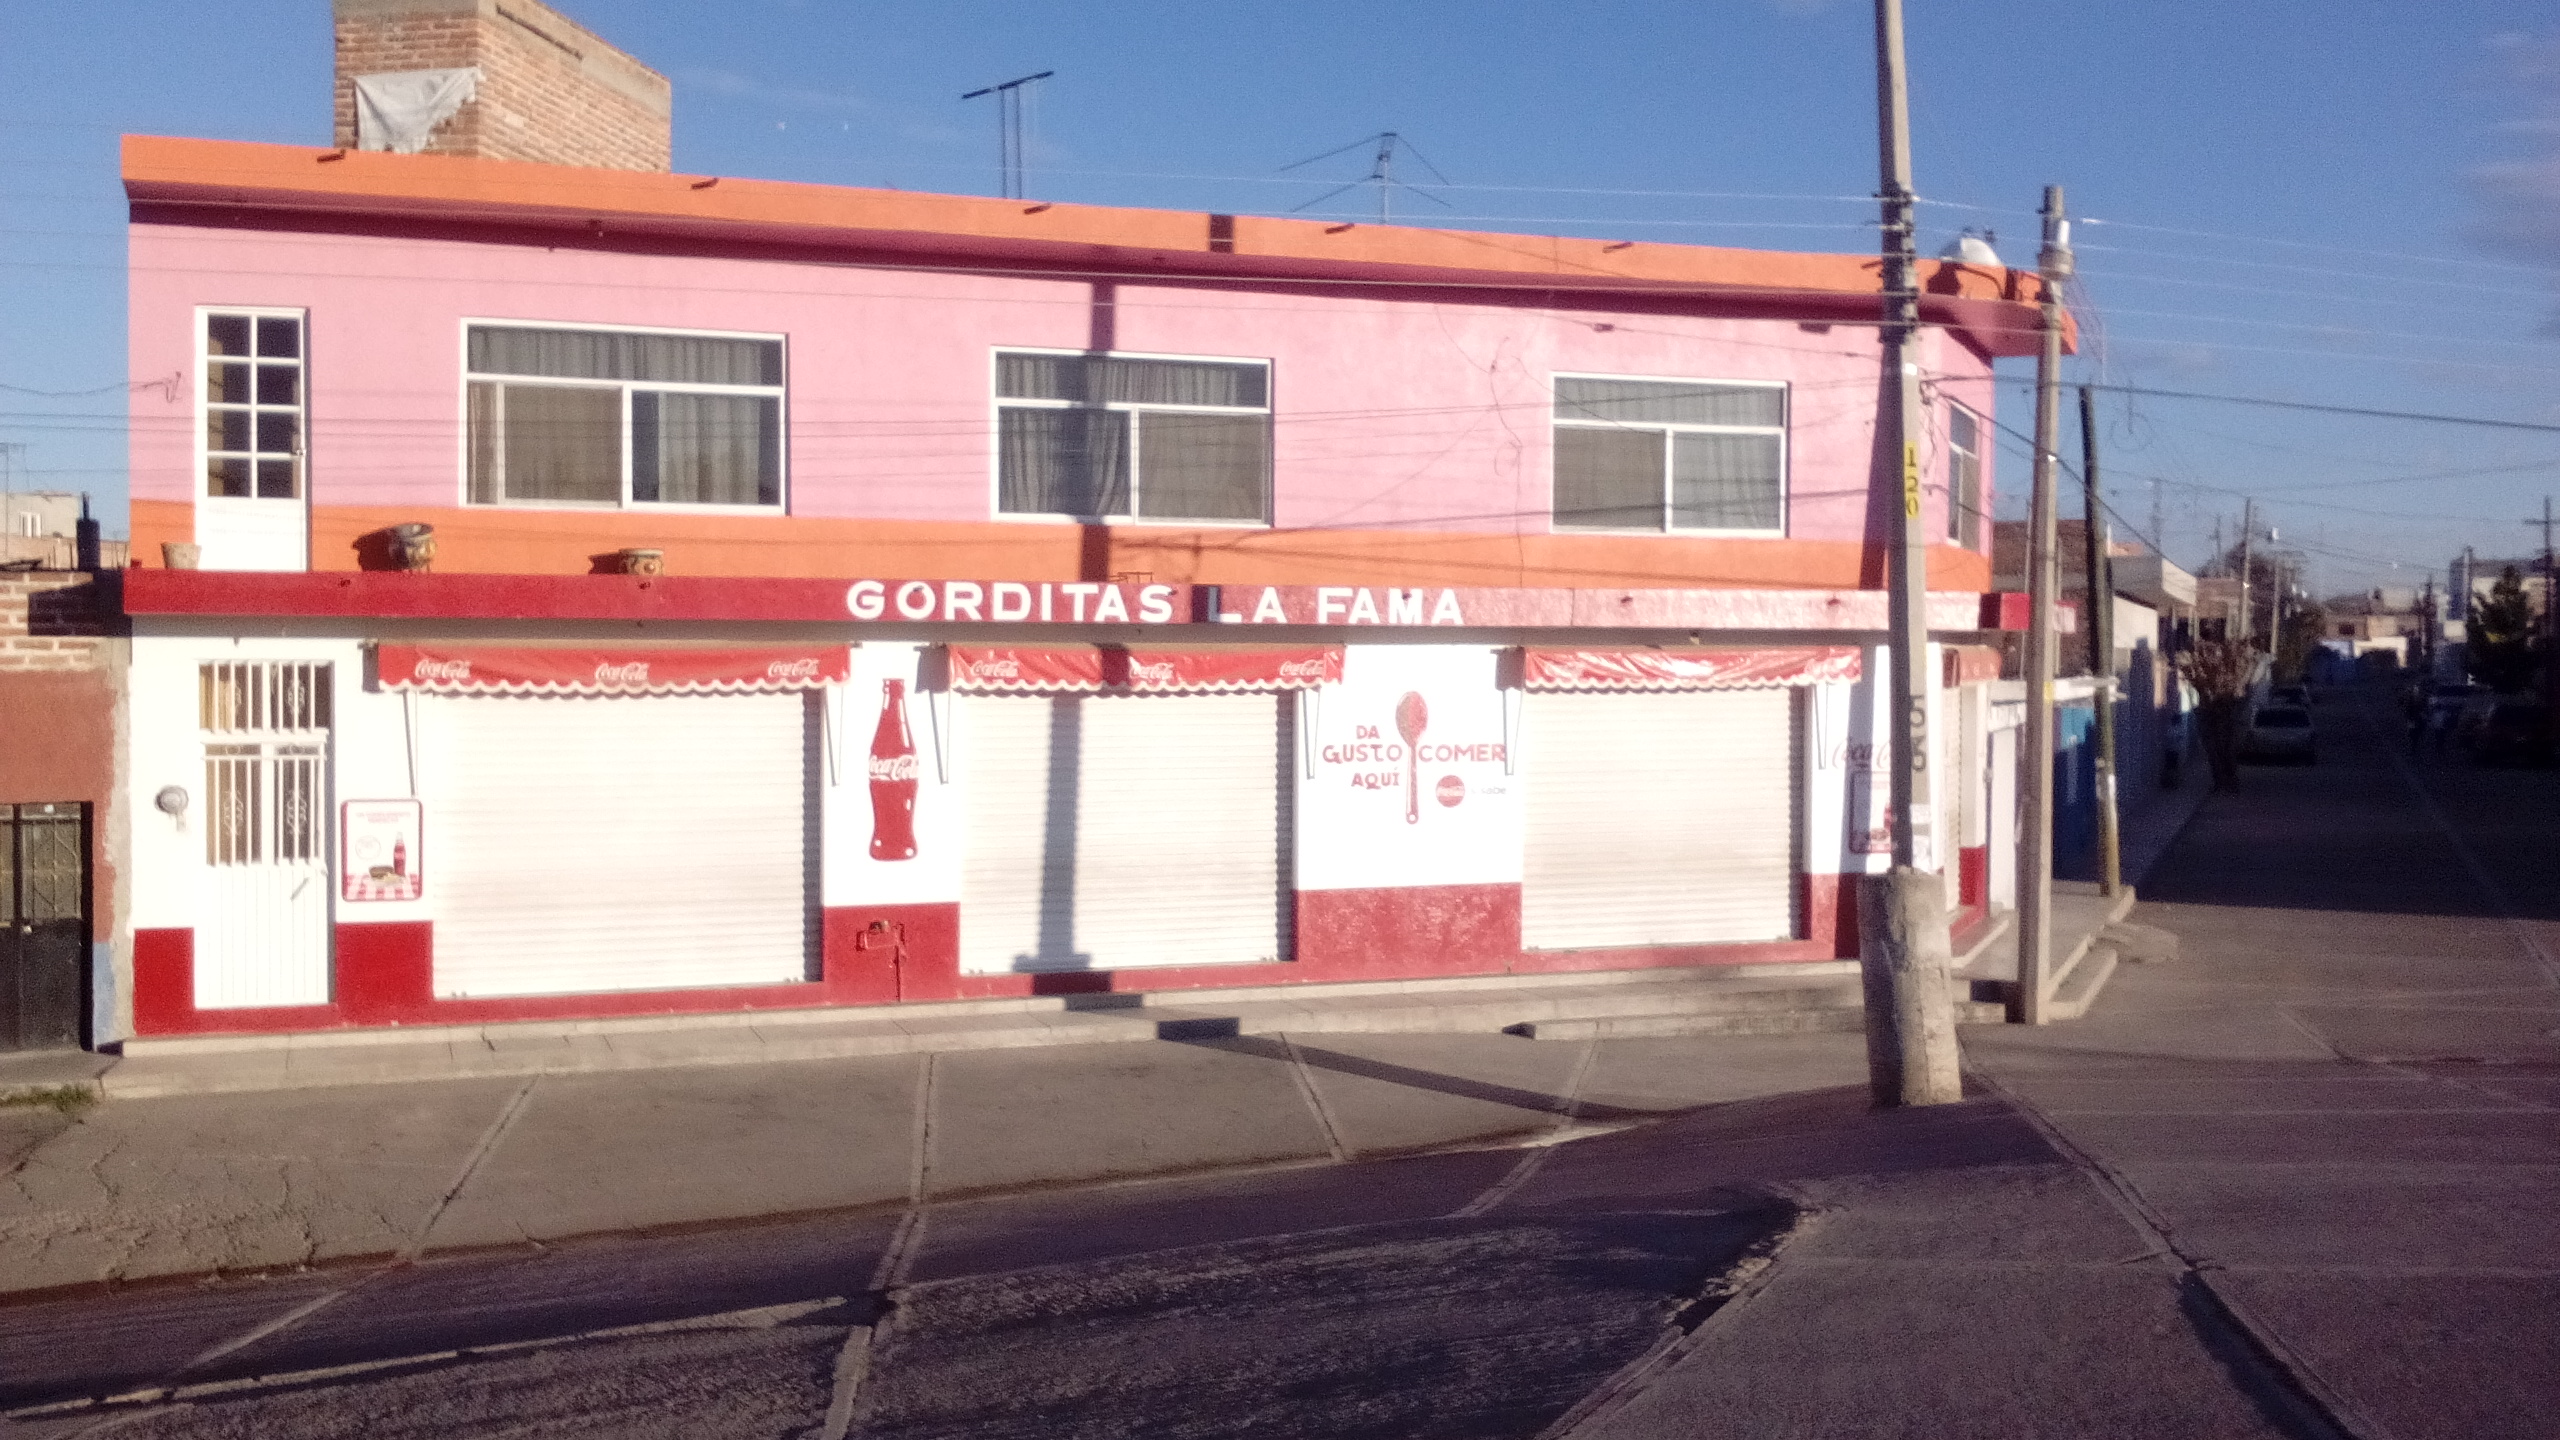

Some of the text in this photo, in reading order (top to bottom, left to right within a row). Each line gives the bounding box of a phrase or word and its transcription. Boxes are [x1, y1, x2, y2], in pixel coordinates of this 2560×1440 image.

[847, 580, 1465, 626] GORDITAS LA FAMA
[1356, 725, 1380, 740] DA
[1322, 743, 1506, 764] GUSTO COMER
